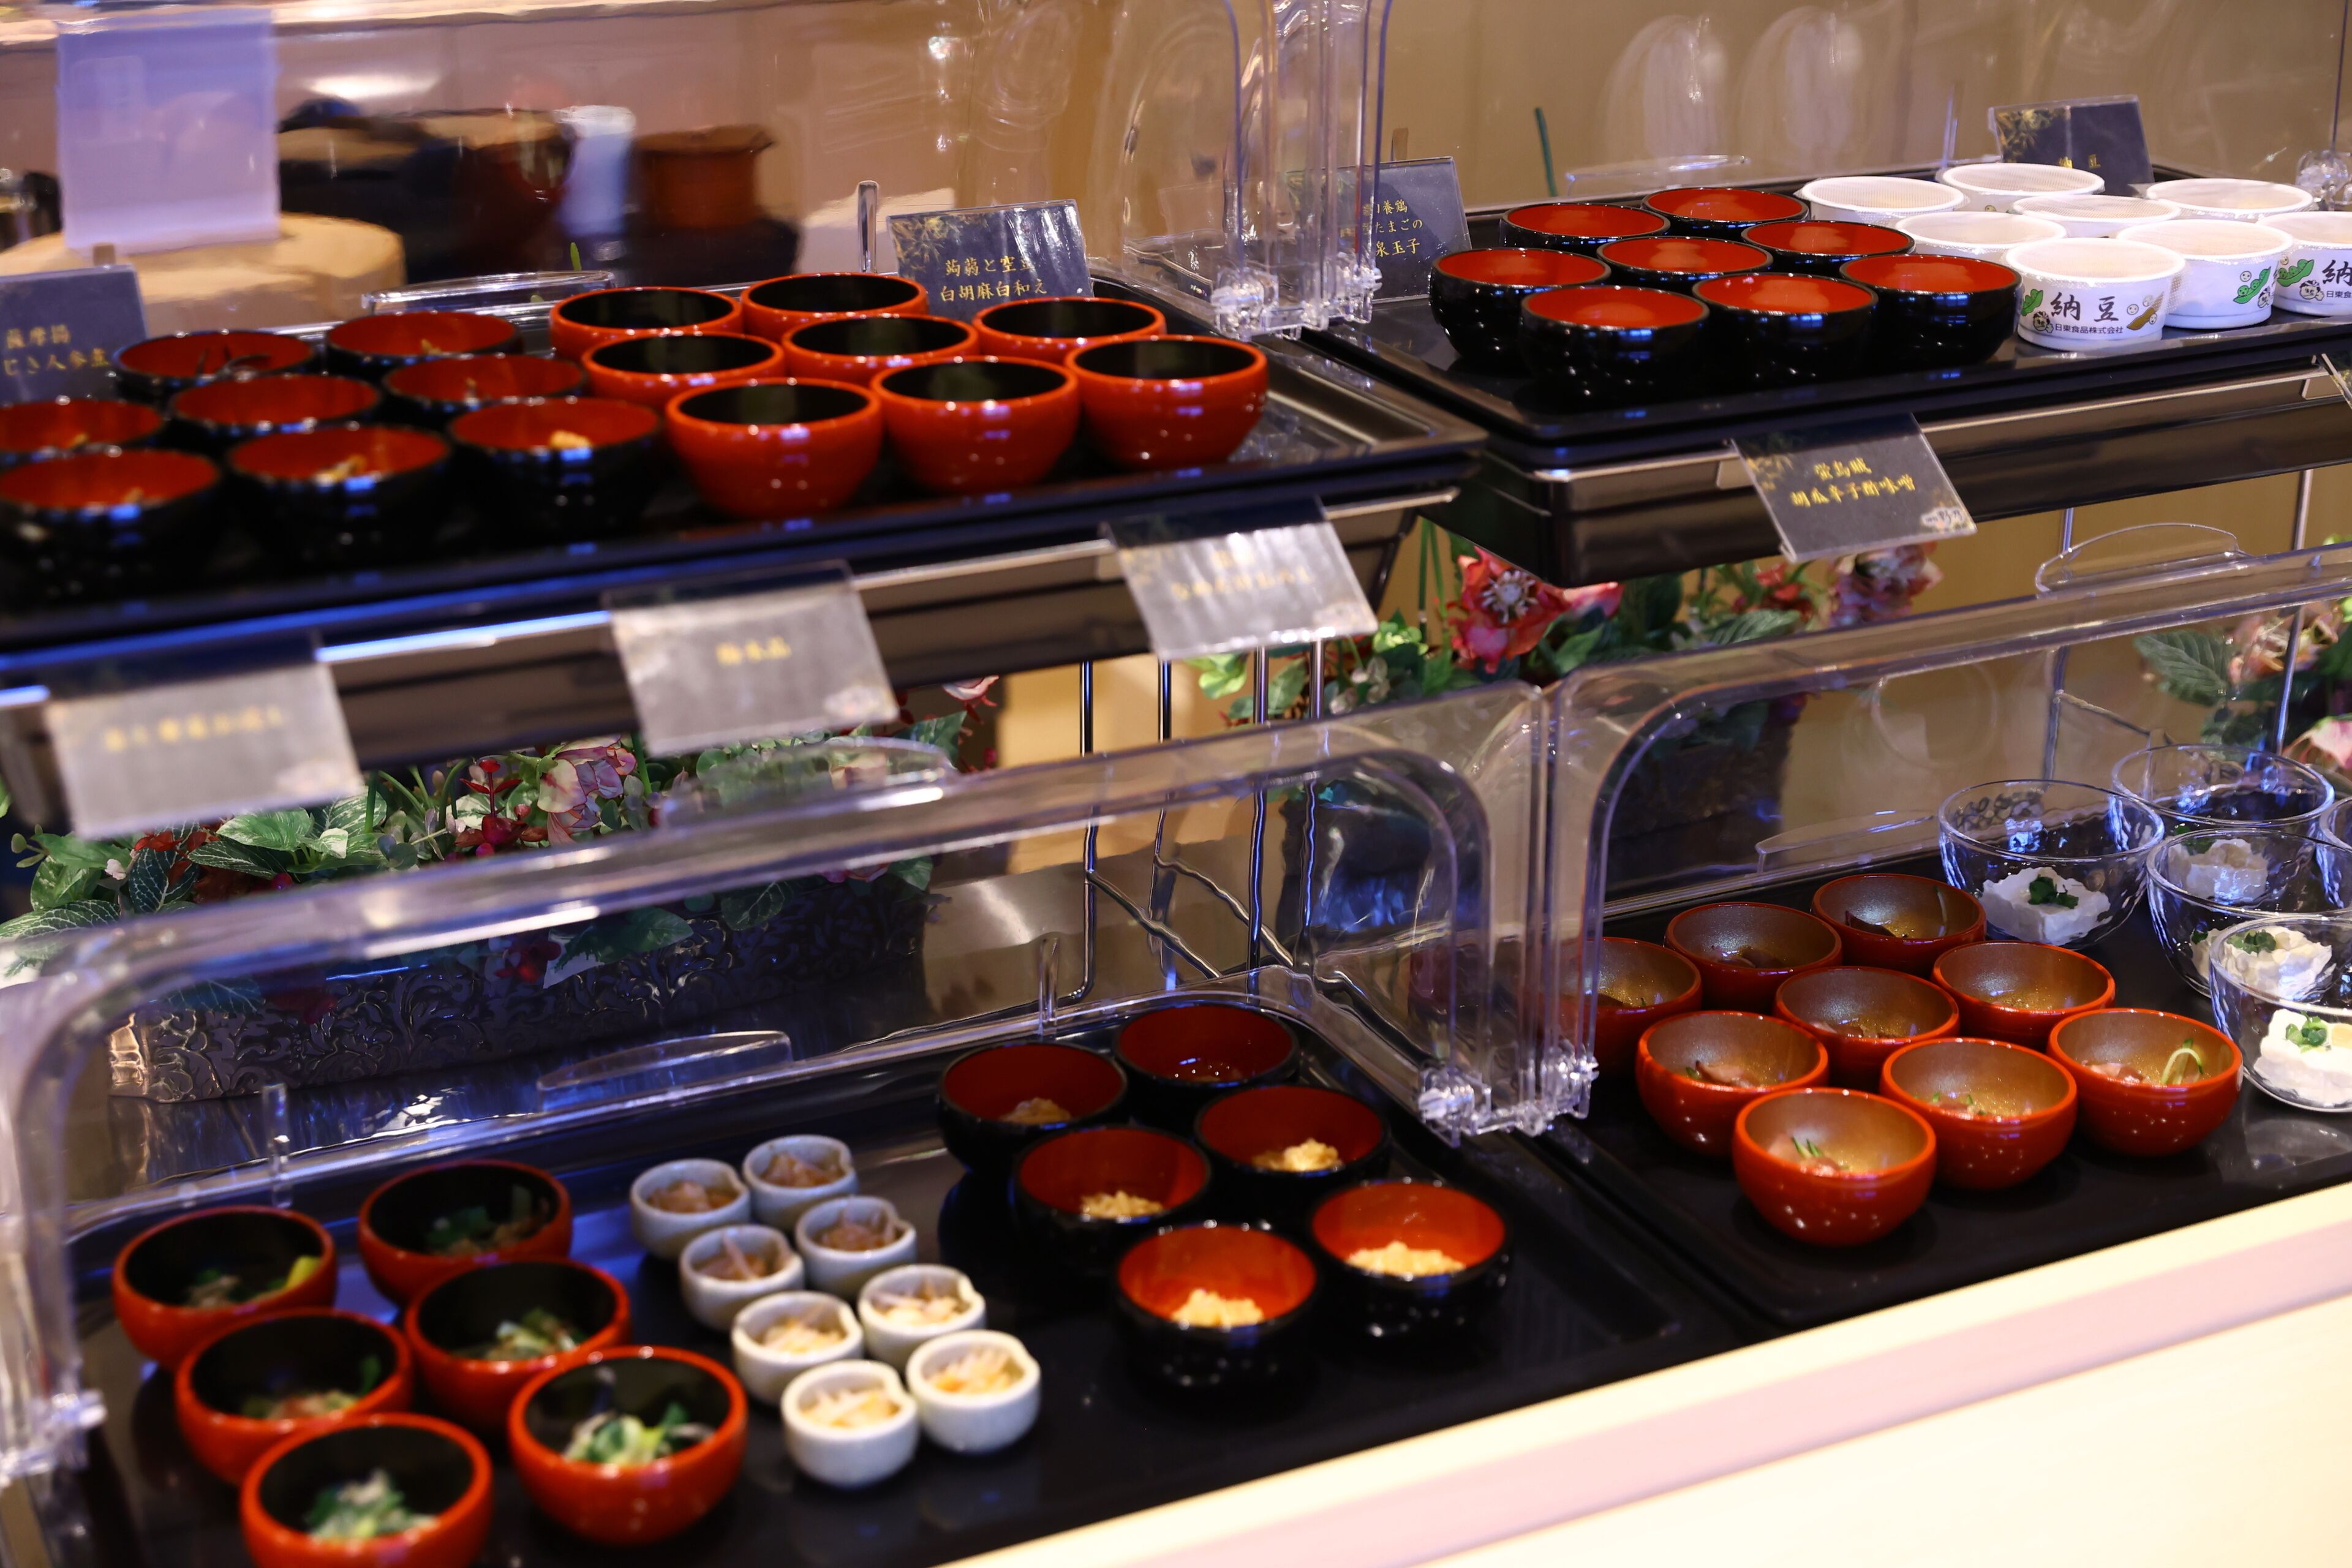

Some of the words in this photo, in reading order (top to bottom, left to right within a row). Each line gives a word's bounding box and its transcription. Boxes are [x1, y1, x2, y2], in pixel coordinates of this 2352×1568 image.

[940, 279, 1047, 302] 白胡麻白和え
[2050, 292, 2119, 322] 納豆
[2056, 323, 2124, 334] 日東食品株式会社
